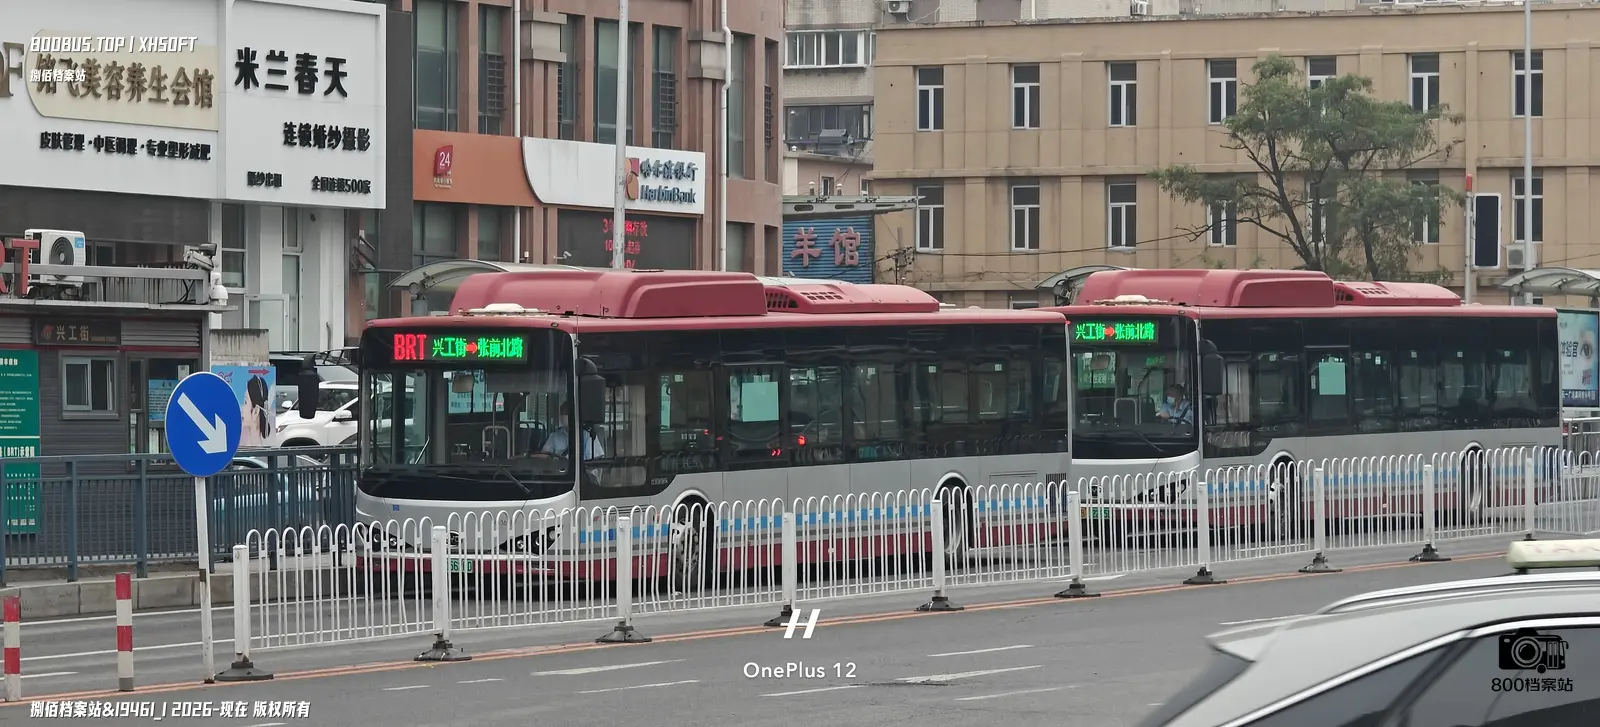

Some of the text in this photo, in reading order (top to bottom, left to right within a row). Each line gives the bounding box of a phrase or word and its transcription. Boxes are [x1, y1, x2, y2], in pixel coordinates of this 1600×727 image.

[234, 46, 348, 98] 米兰春天
[283, 121, 371, 151] 连锁婚纱摄影
[439, 151, 451, 168] 24
[640, 184, 697, 204] HarbinBank
[791, 226, 861, 268] 羊馆
[56, 324, 90, 342] 兴工街
[1075, 321, 1155, 341] 兴工街 张前北路
[393, 333, 524, 361] BRT 兴工街 张前北路
